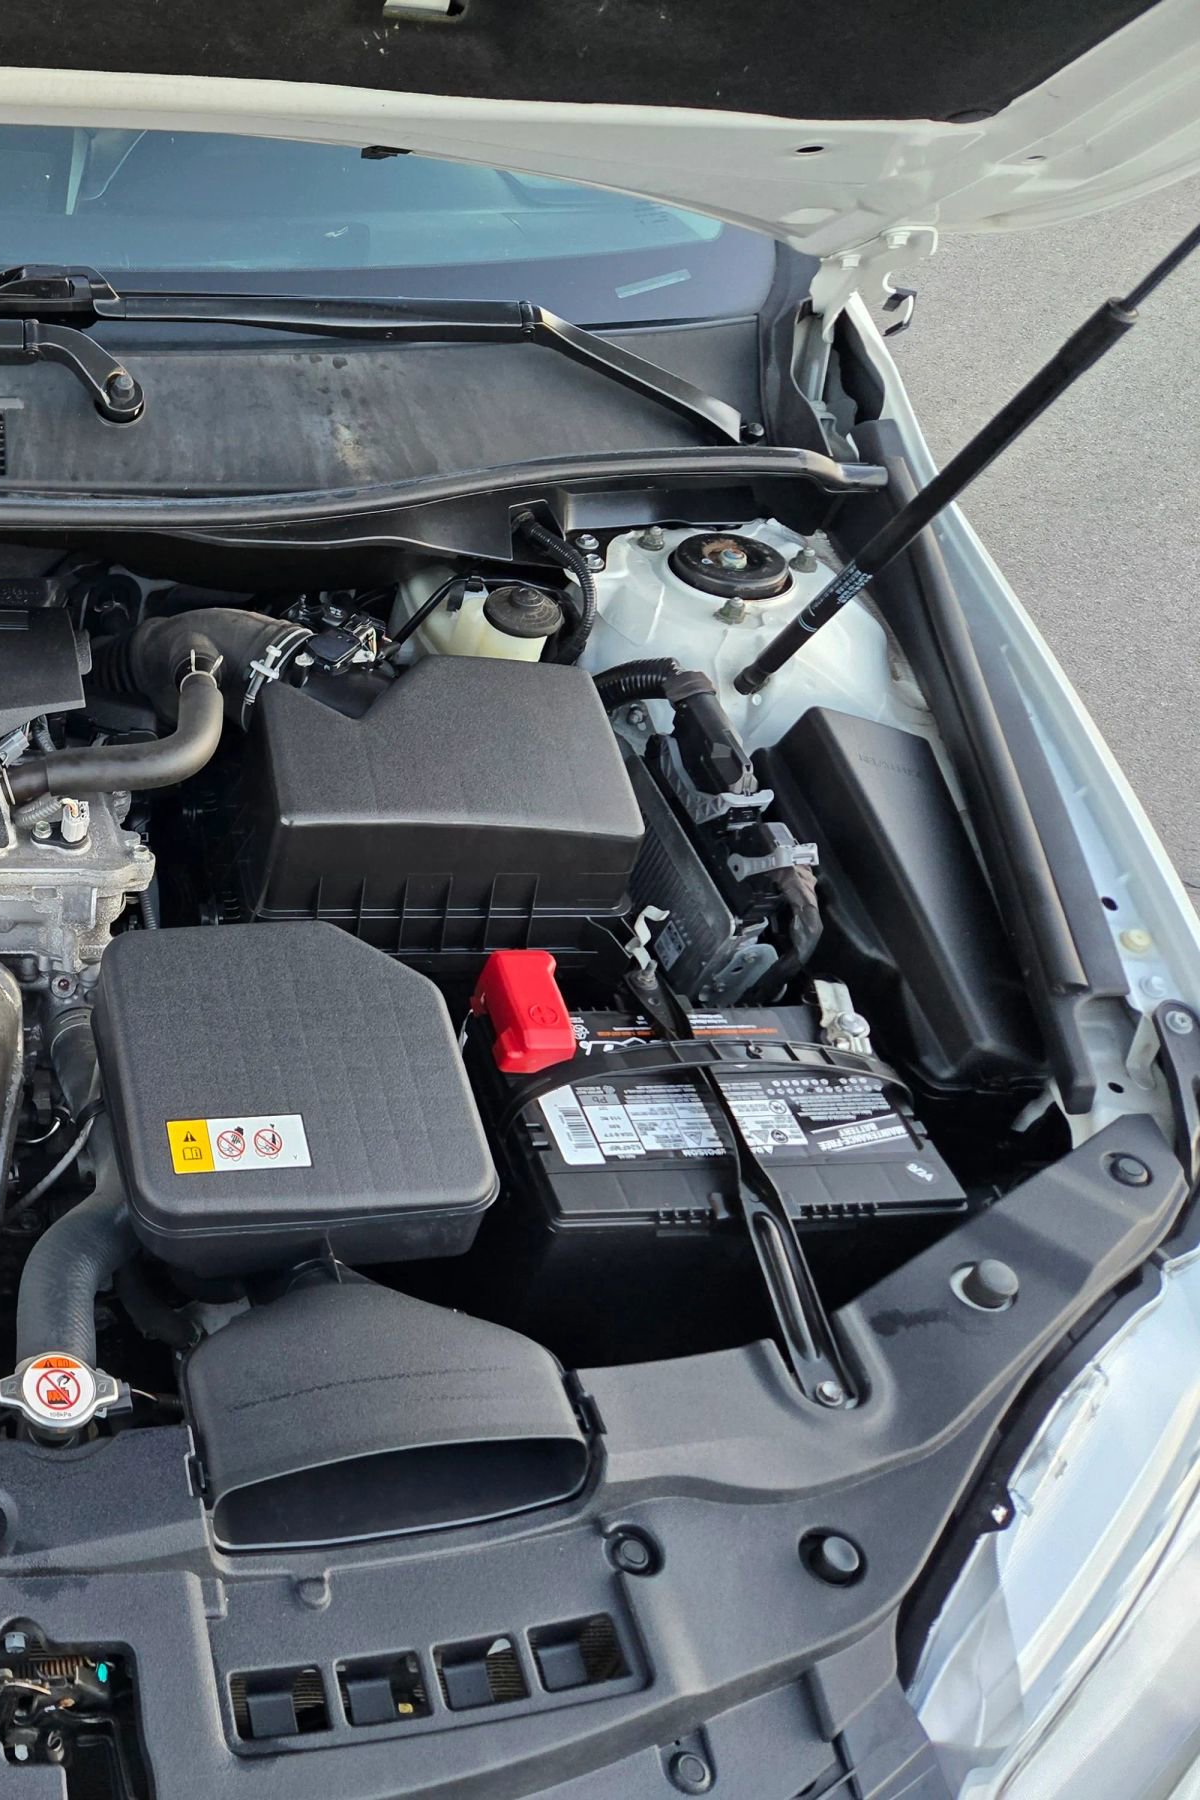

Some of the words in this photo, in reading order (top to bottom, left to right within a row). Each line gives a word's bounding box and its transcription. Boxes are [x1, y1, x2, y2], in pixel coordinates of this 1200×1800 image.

[592, 1096, 608, 1104] Pb
[838, 1122, 878, 1137] BATTERY
[817, 1125, 907, 1151] MAINTENANCE-FREE
